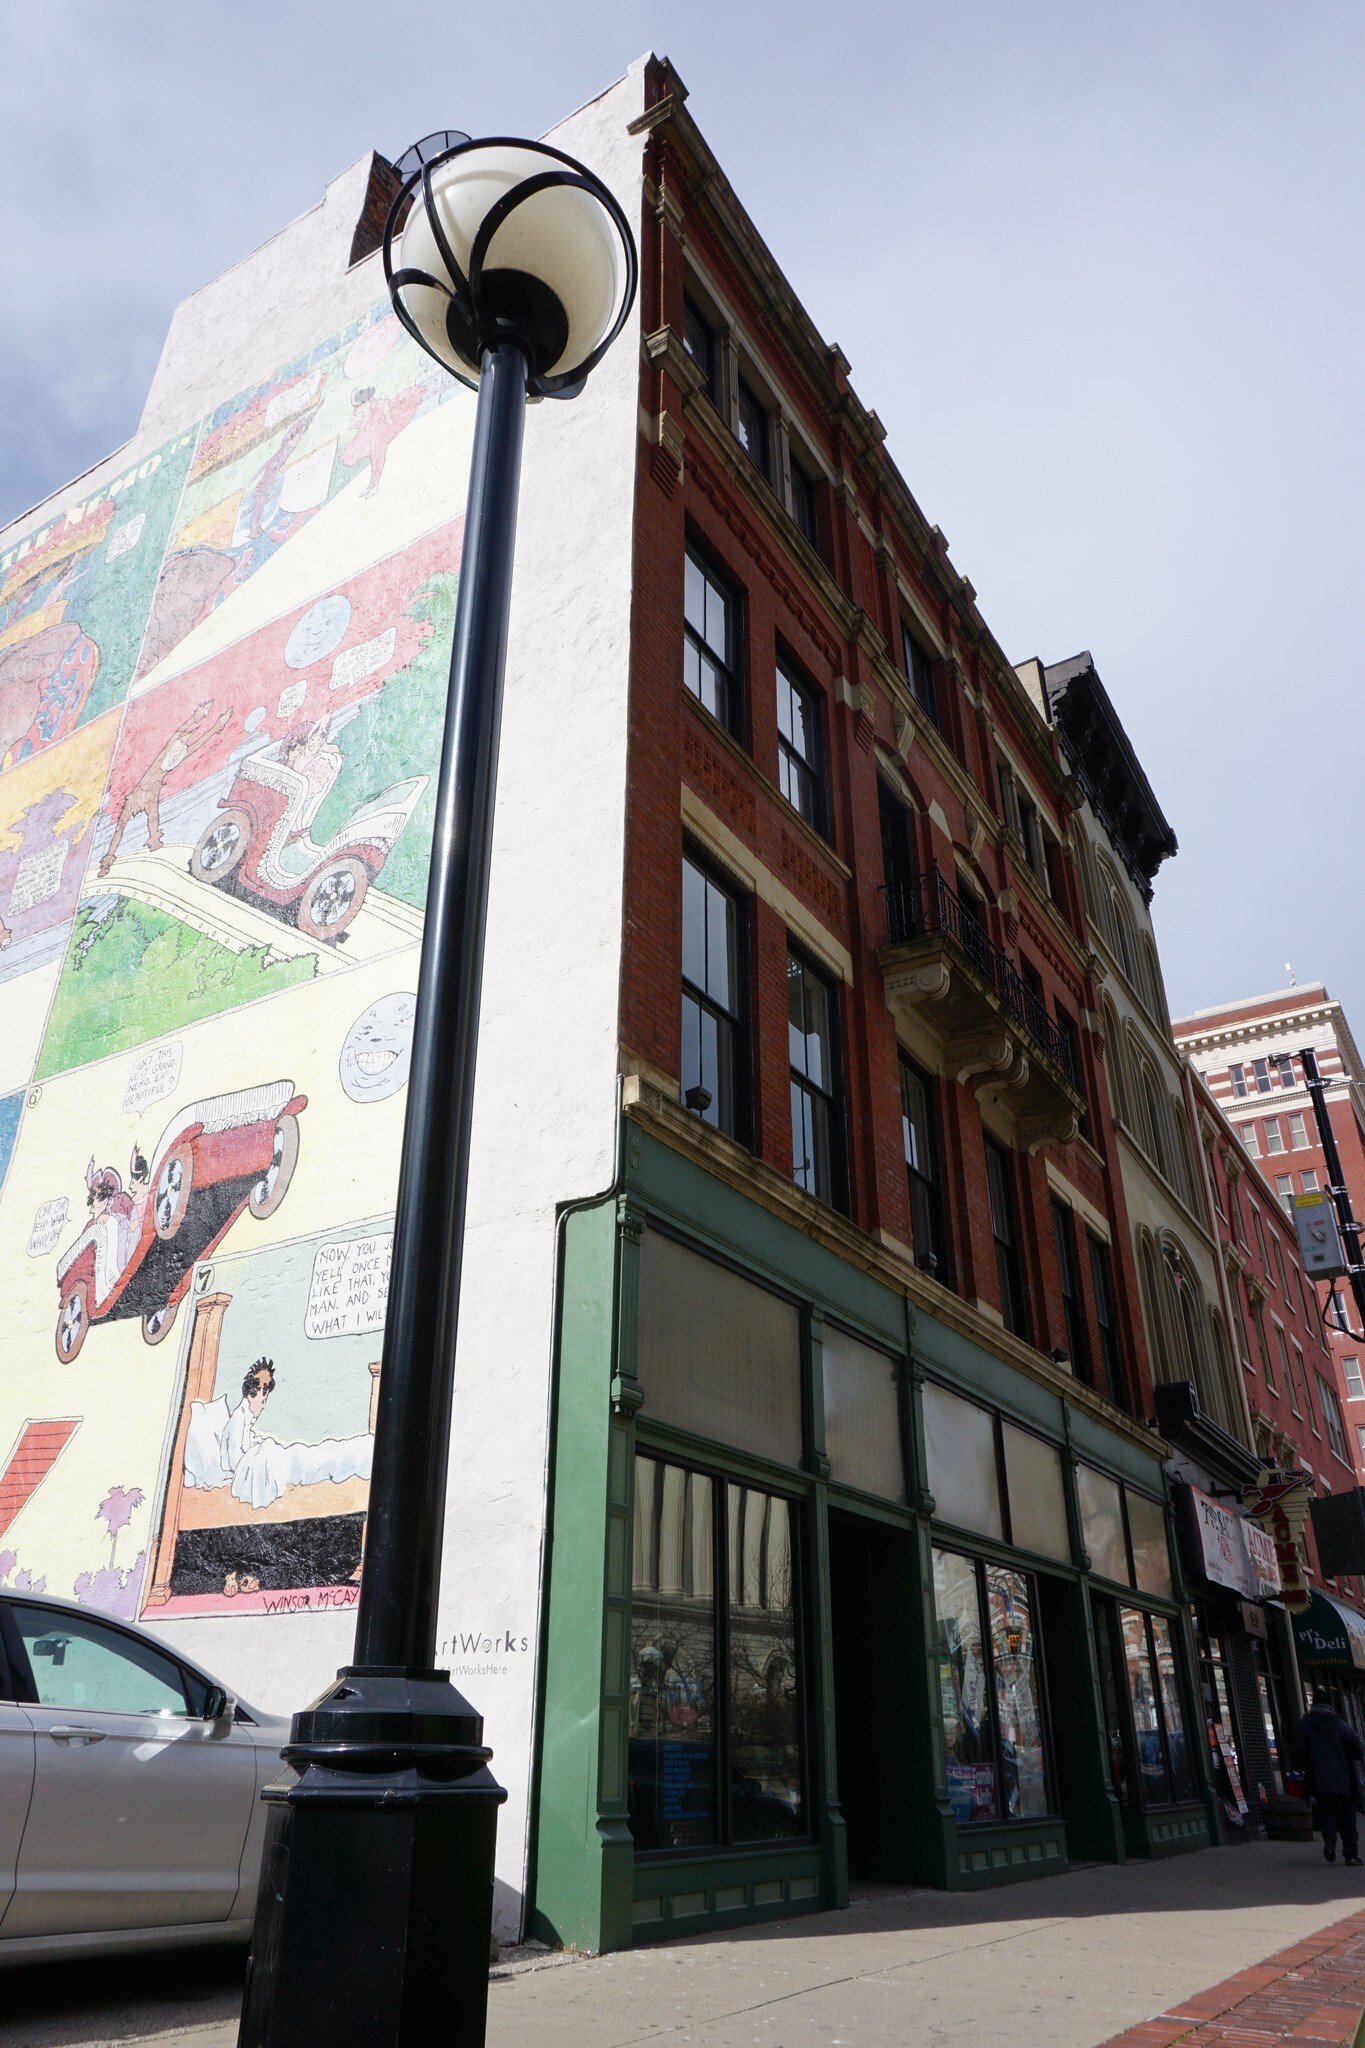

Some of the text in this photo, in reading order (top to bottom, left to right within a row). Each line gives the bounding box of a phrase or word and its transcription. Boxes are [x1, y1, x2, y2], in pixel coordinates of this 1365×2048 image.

[64, 455, 161, 531] NEMO
[171, 433, 192, 455] IN
[158, 1047, 173, 1060] THIS
[29, 1089, 38, 1105] 6
[357, 1241, 376, 1257] YOU
[199, 1269, 212, 1291] 7
[316, 1266, 342, 1285] YELL
[352, 1257, 380, 1274] ONCE
[312, 1282, 340, 1299] LIKE
[346, 1290, 369, 1307] AND
[312, 1314, 347, 1334] WHAT
[357, 1313, 360, 1326] I
[1272, 1503, 1299, 1583] ACME
[263, 1594, 312, 1614] WINSOR
[435, 1630, 528, 1656] rtWorks
[1314, 1637, 1347, 1650] Deli
